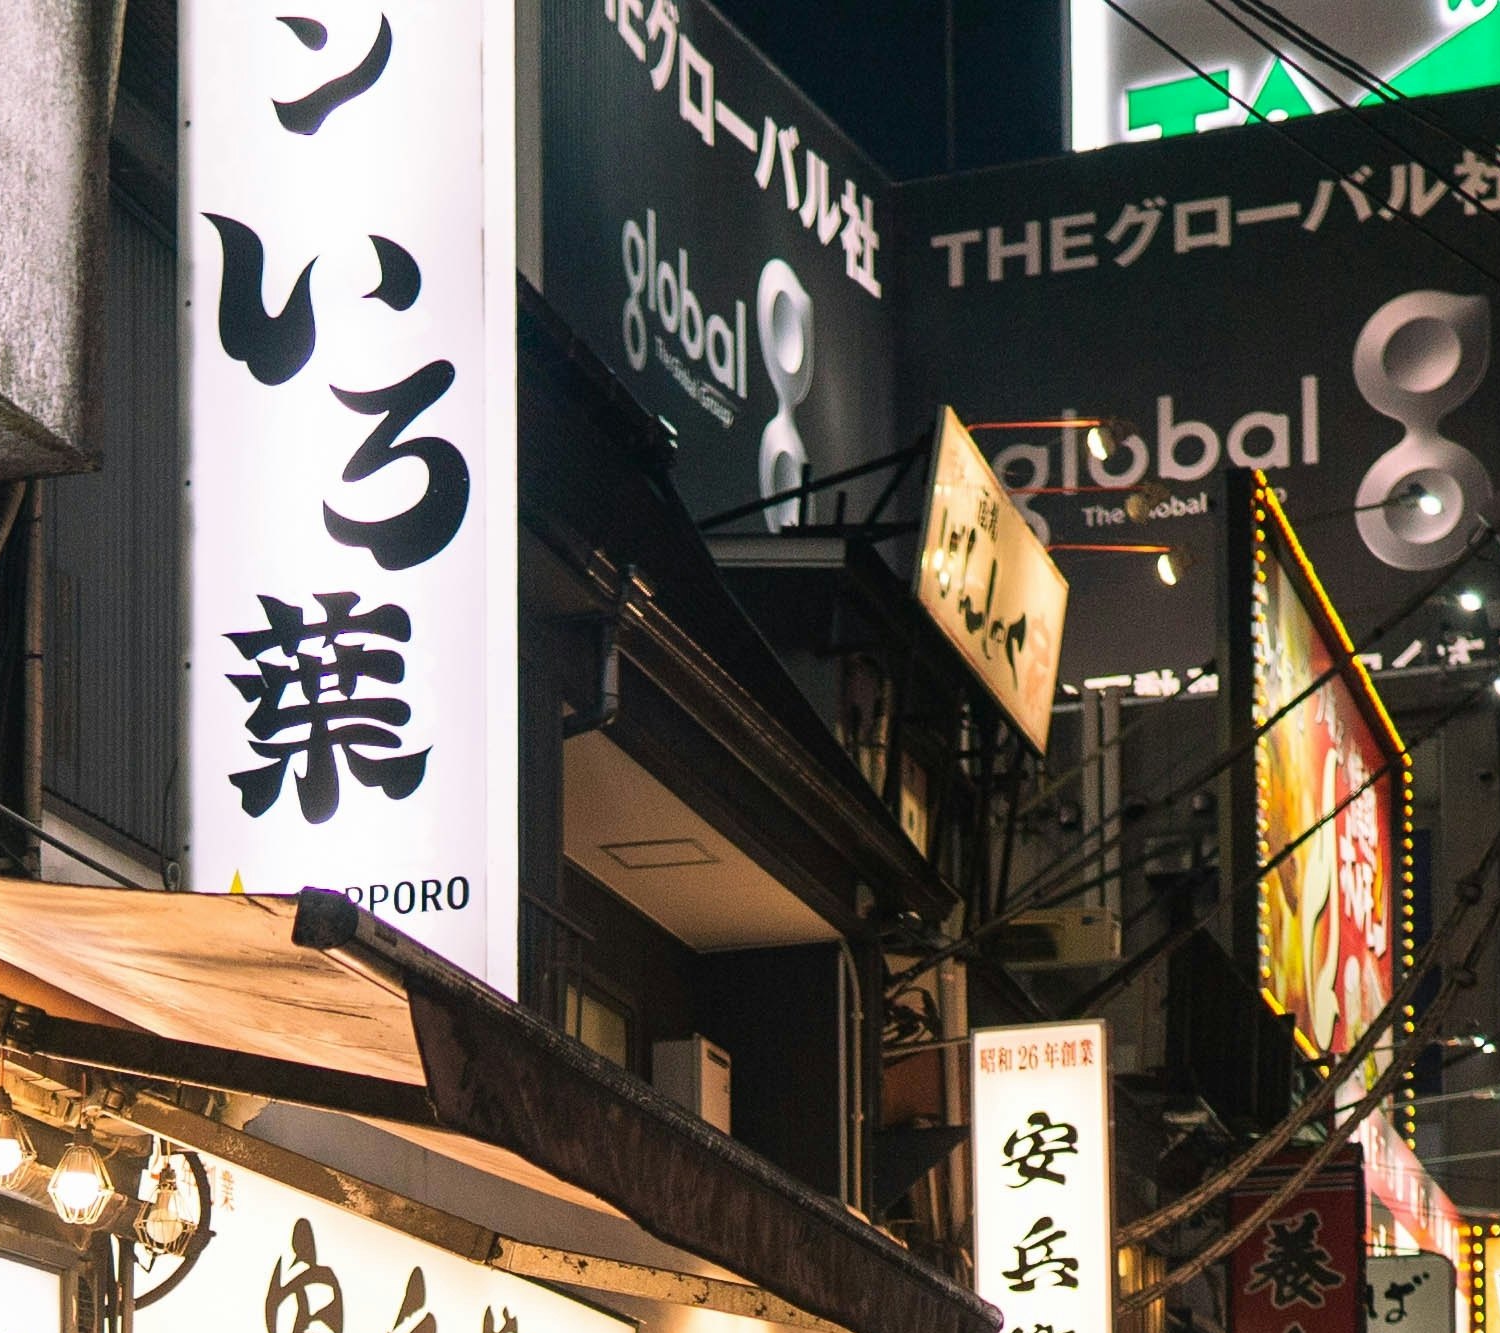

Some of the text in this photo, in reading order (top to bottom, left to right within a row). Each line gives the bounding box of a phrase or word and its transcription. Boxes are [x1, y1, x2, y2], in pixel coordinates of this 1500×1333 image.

[606, 0, 882, 299] Eグローバル社
[622, 209, 747, 399] global
[200, 211, 472, 824] いろ葉
[1081, 505, 1125, 528] The
[345, 876, 469, 914] PPORO
